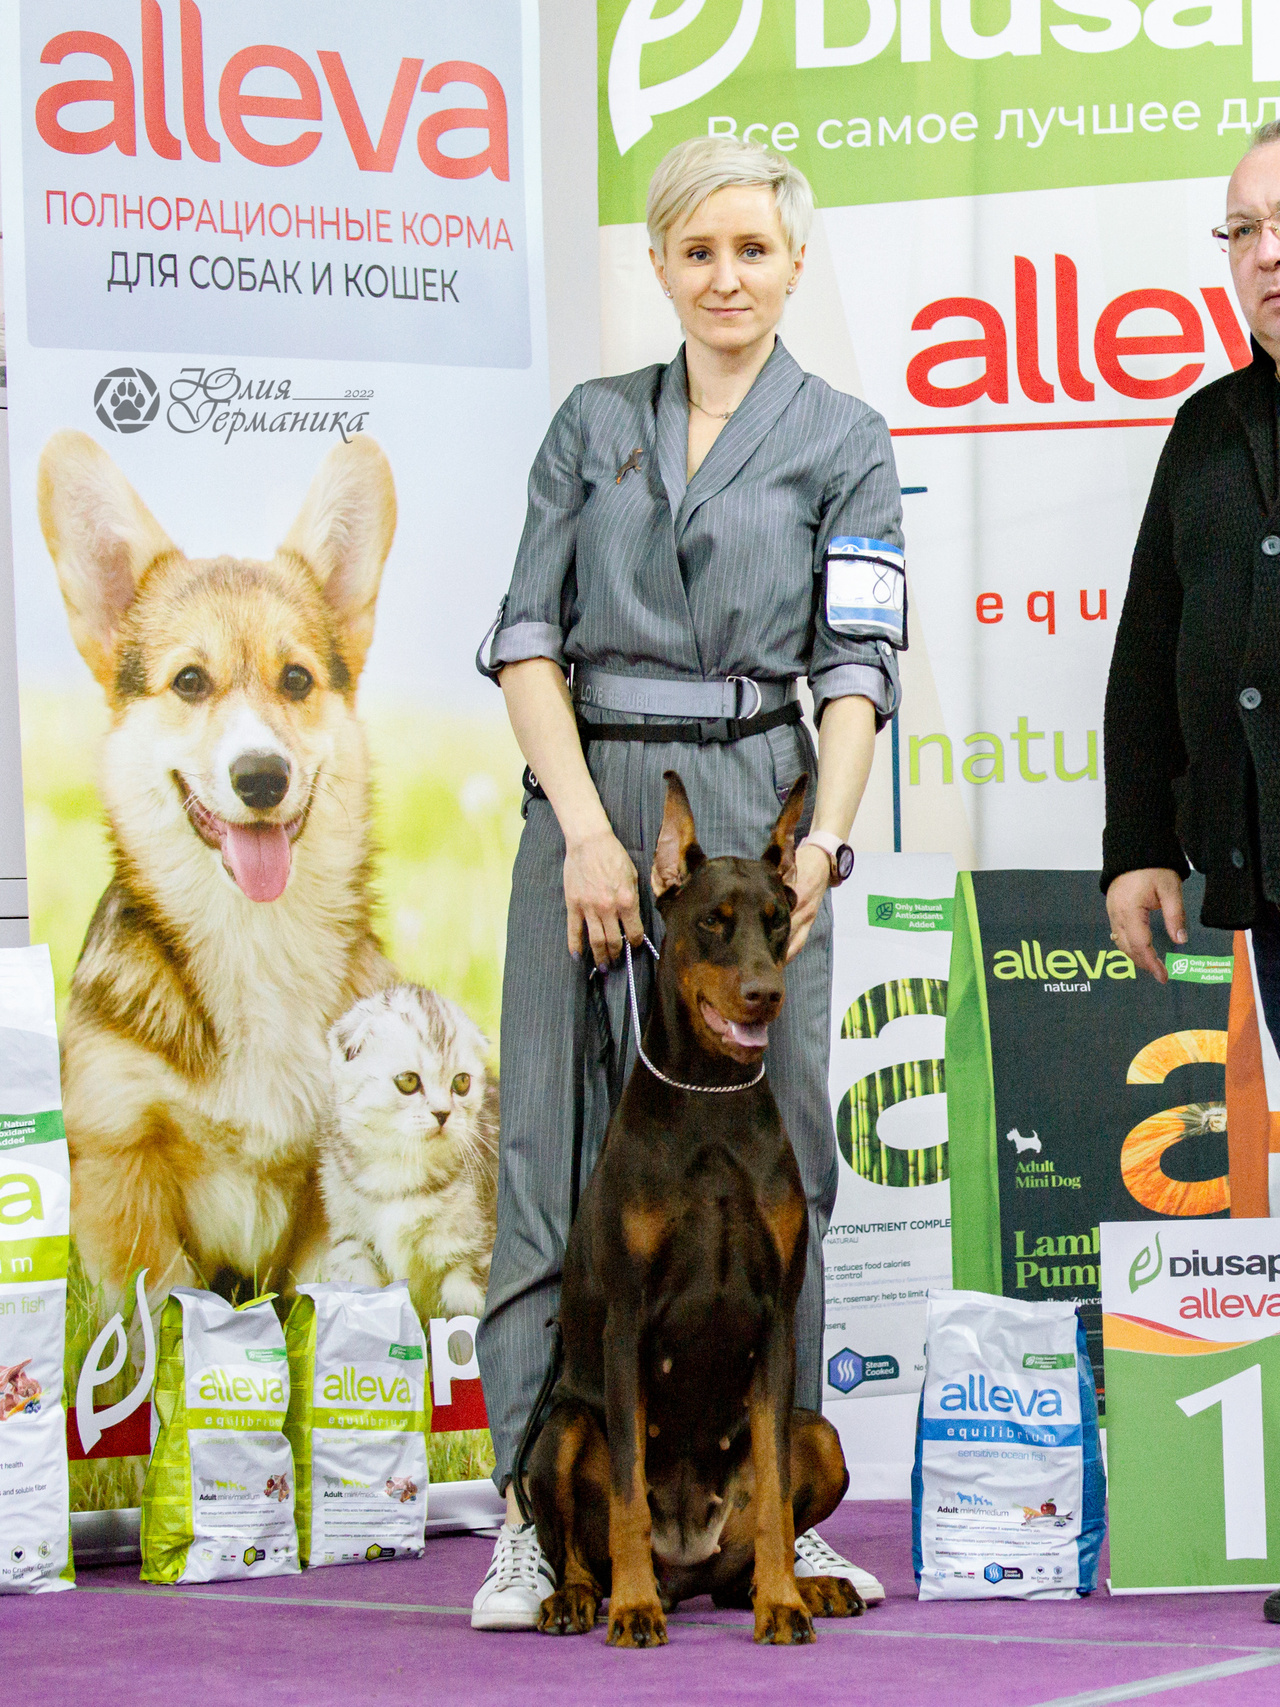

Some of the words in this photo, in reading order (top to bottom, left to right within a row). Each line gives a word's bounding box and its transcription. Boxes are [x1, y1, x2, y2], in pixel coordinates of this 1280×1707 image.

[35, 0, 510, 182] alleva
[708, 116, 800, 151] Все
[816, 111, 979, 149] самое
[994, 101, 1201, 148] лучшее
[45, 190, 393, 242] ПОЛНОРАЦИОННЫЕ
[402, 212, 514, 252] КОРМА
[107, 251, 178, 292] ДЛЯ
[189, 255, 303, 295] СОБАК
[312, 262, 332, 296] И
[345, 263, 460, 303] КОШЕК
[895, 903, 913, 911] Only
[895, 912, 943, 920] Antioxidants
[993, 939, 1136, 980] alleva
[1044, 981, 1091, 992] natural
[4, 1119, 36, 1128] Natural
[1015, 1160, 1055, 1174] Adult
[1016, 1175, 1049, 1189] Mini
[1051, 1175, 1082, 1190] Dog
[834, 1264, 863, 1272] reduces
[865, 1261, 881, 1269] food
[883, 1260, 911, 1269] calories
[836, 1271, 862, 1280] control
[843, 1294, 880, 1303] rosemary:
[881, 1292, 897, 1301] help
[908, 1290, 924, 1298] limit
[22, 1295, 46, 1315] fish
[865, 1368, 894, 1376] Cooked
[199, 1368, 285, 1403] alleva
[323, 1366, 411, 1403] alleva
[939, 1374, 1063, 1417] alleva
[947, 1426, 1056, 1443] equilibrium
[958, 1448, 999, 1458] sensitive
[1001, 1451, 1030, 1460] ocean
[1032, 1451, 1046, 1462] fish
[1175, 1363, 1267, 1560] 1
[5, 1461, 24, 1469] health
[15, 1487, 34, 1495] soluble
[35, 1484, 47, 1492] fiber
[937, 1505, 959, 1513] Adult
[960, 1507, 1009, 1517] mini/medium
[13, 1565, 34, 1575] Cruelty
